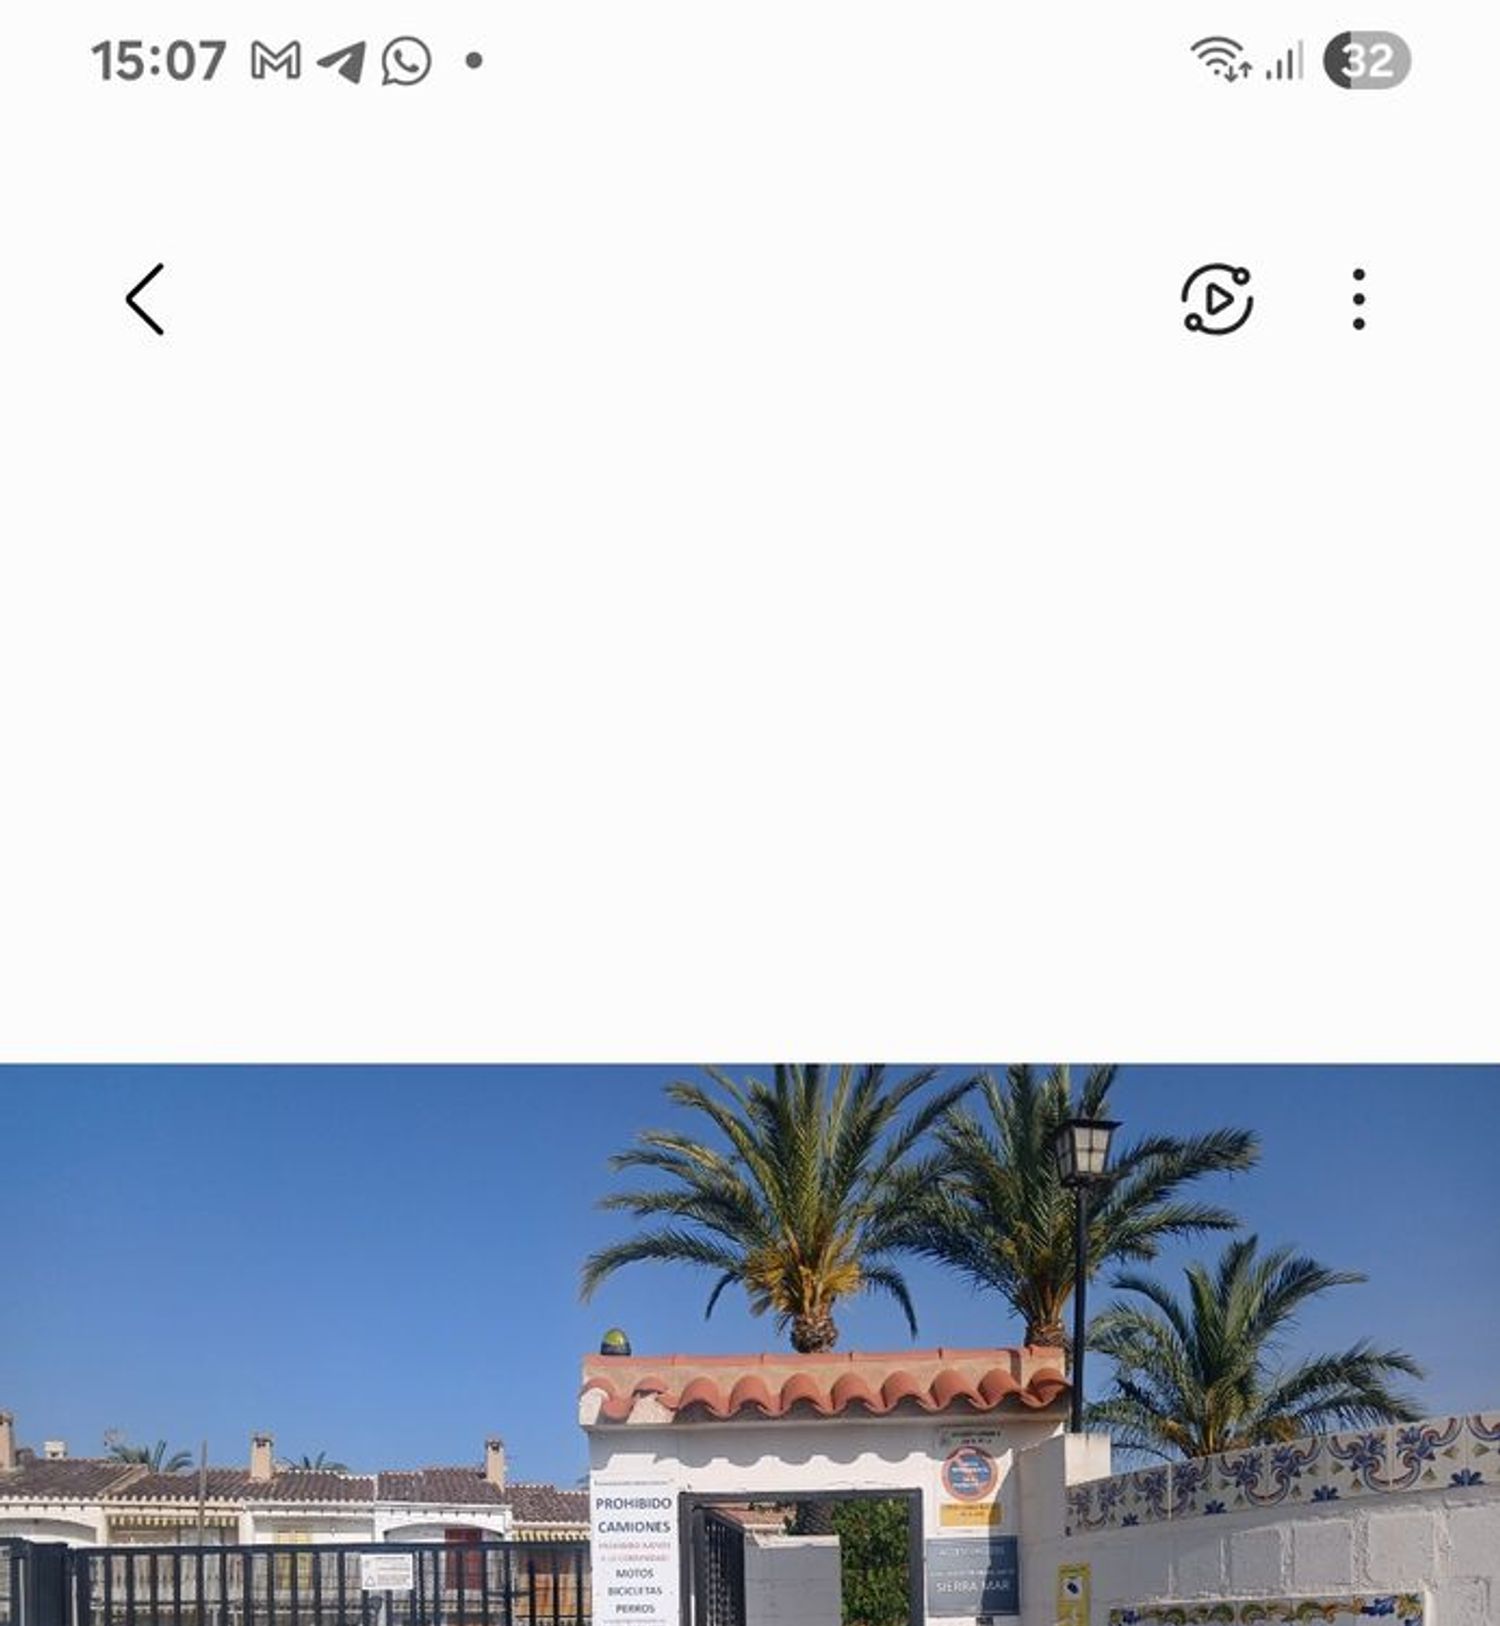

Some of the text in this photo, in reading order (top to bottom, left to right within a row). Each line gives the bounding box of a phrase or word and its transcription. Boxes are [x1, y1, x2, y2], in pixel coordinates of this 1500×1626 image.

[596, 1497, 672, 1510] PROHIBIDO
[598, 1521, 671, 1534] CAMIONES
[615, 1568, 654, 1579] MOTOS
[607, 1586, 663, 1597] BICICLETAS
[936, 1579, 1010, 1594] SIERRA MAR
[615, 1603, 656, 1614] PERROS
